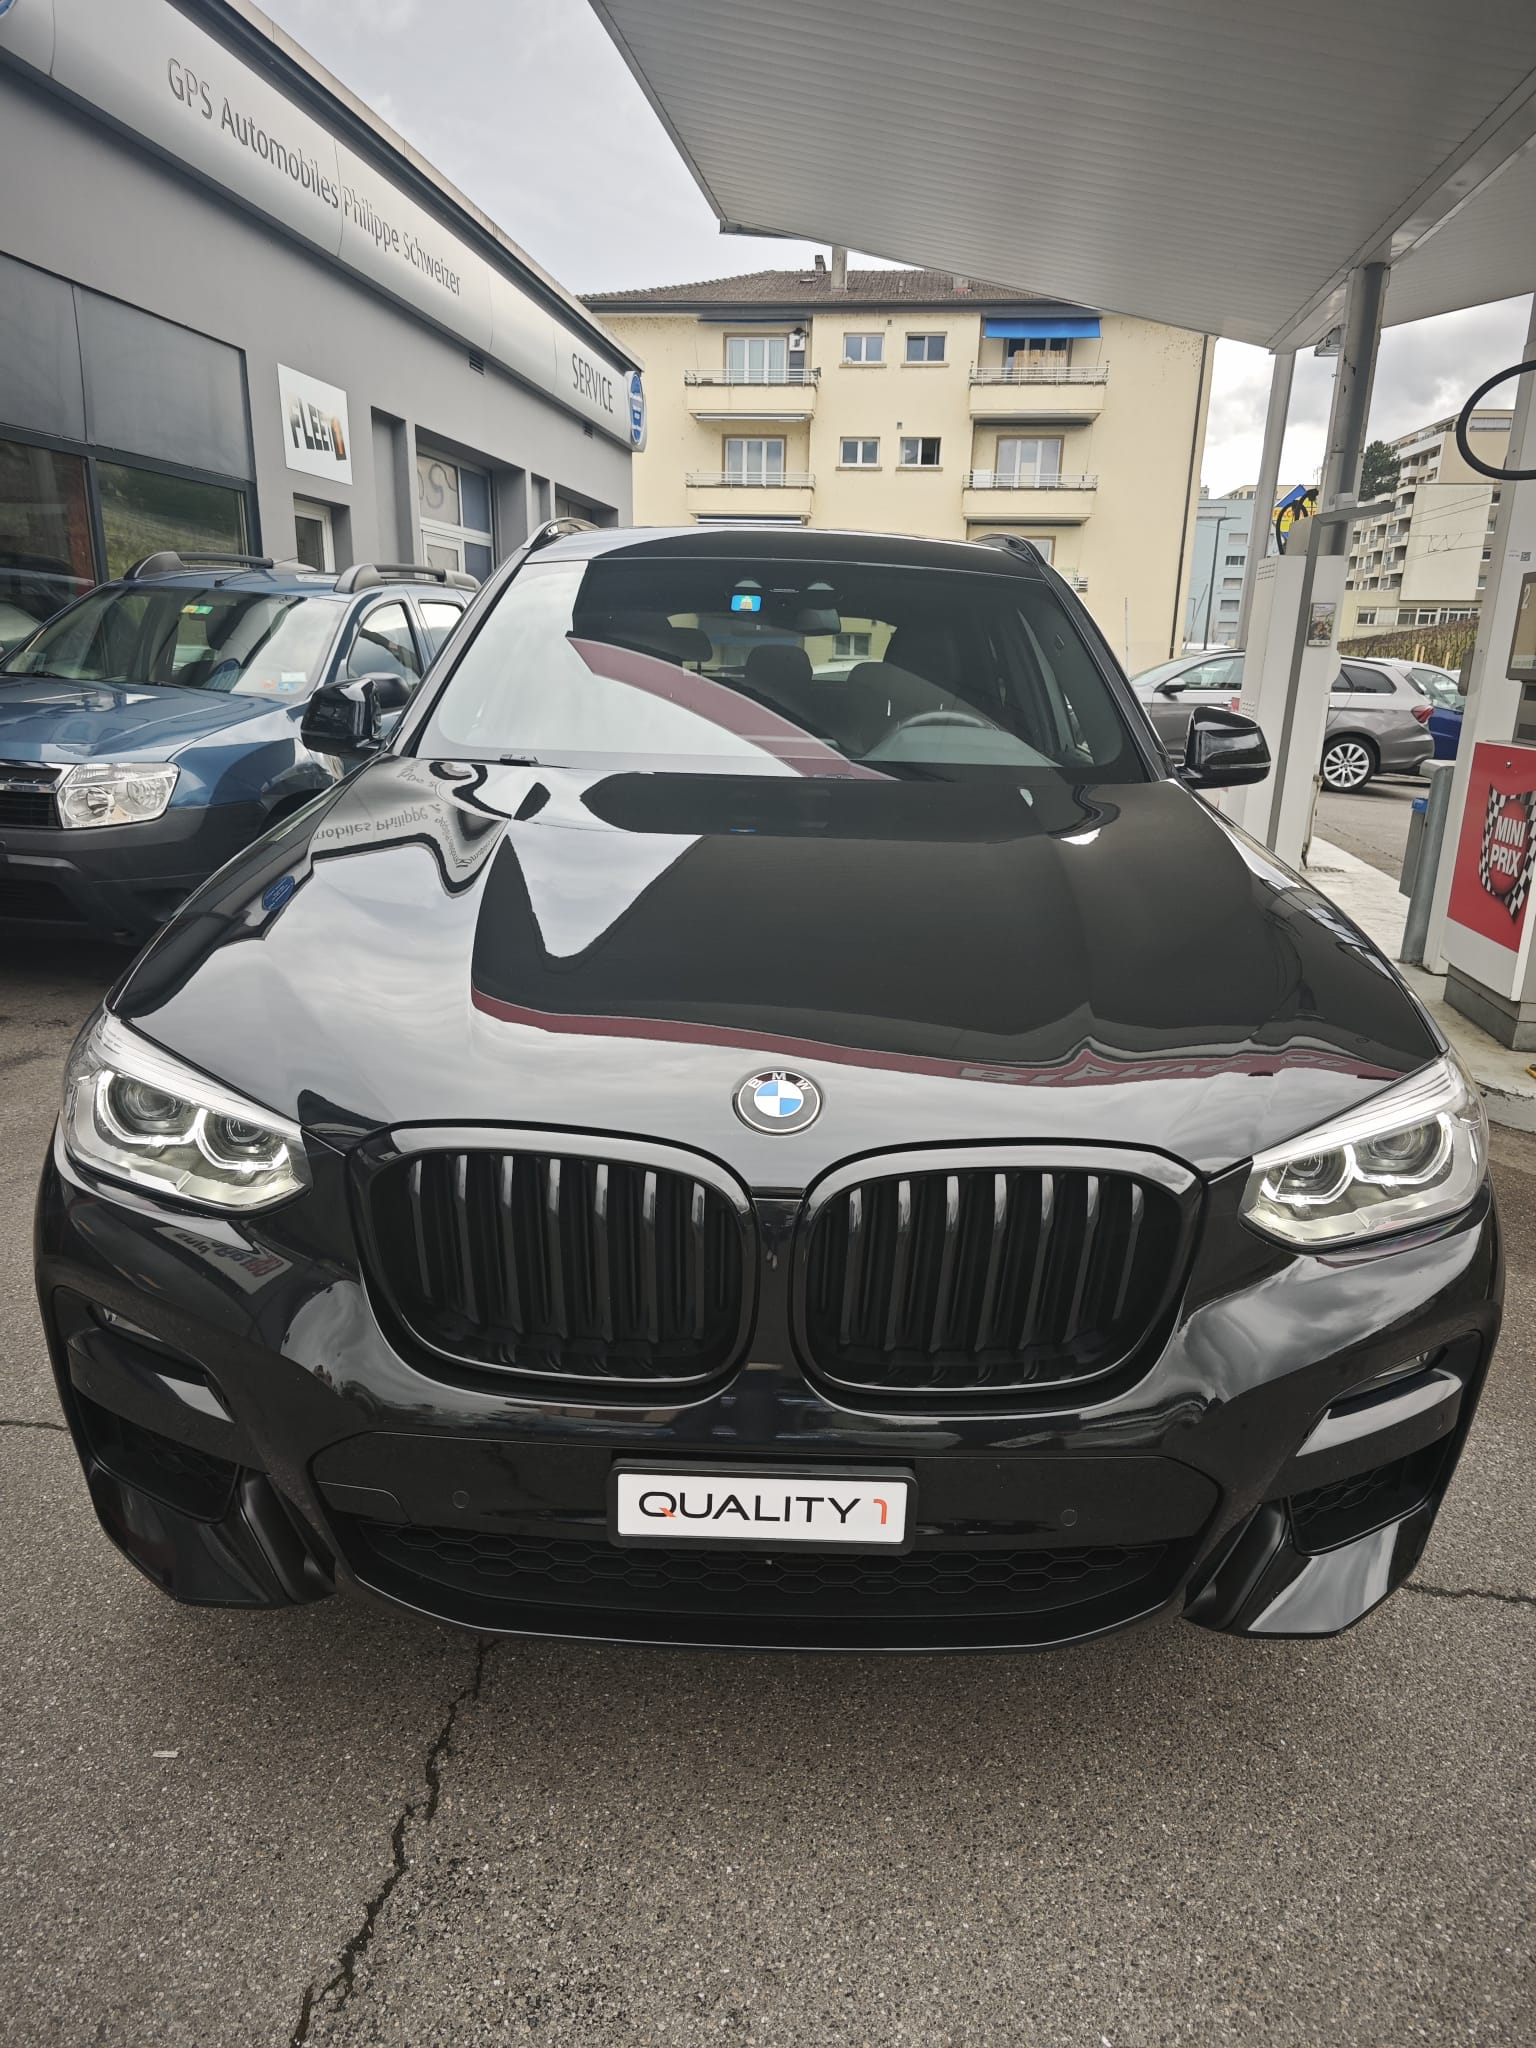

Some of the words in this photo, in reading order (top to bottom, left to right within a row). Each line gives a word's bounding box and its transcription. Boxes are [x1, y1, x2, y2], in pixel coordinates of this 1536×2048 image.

[167, 57, 213, 120] GPS
[221, 97, 339, 209] Automobiles
[342, 185, 400, 253] Philippe
[403, 231, 461, 296] Schweizer
[572, 352, 614, 414] SERVICE
[1494, 815, 1526, 848] MINI
[1488, 843, 1522, 878] PRIX
[747, 1071, 812, 1090] BMW
